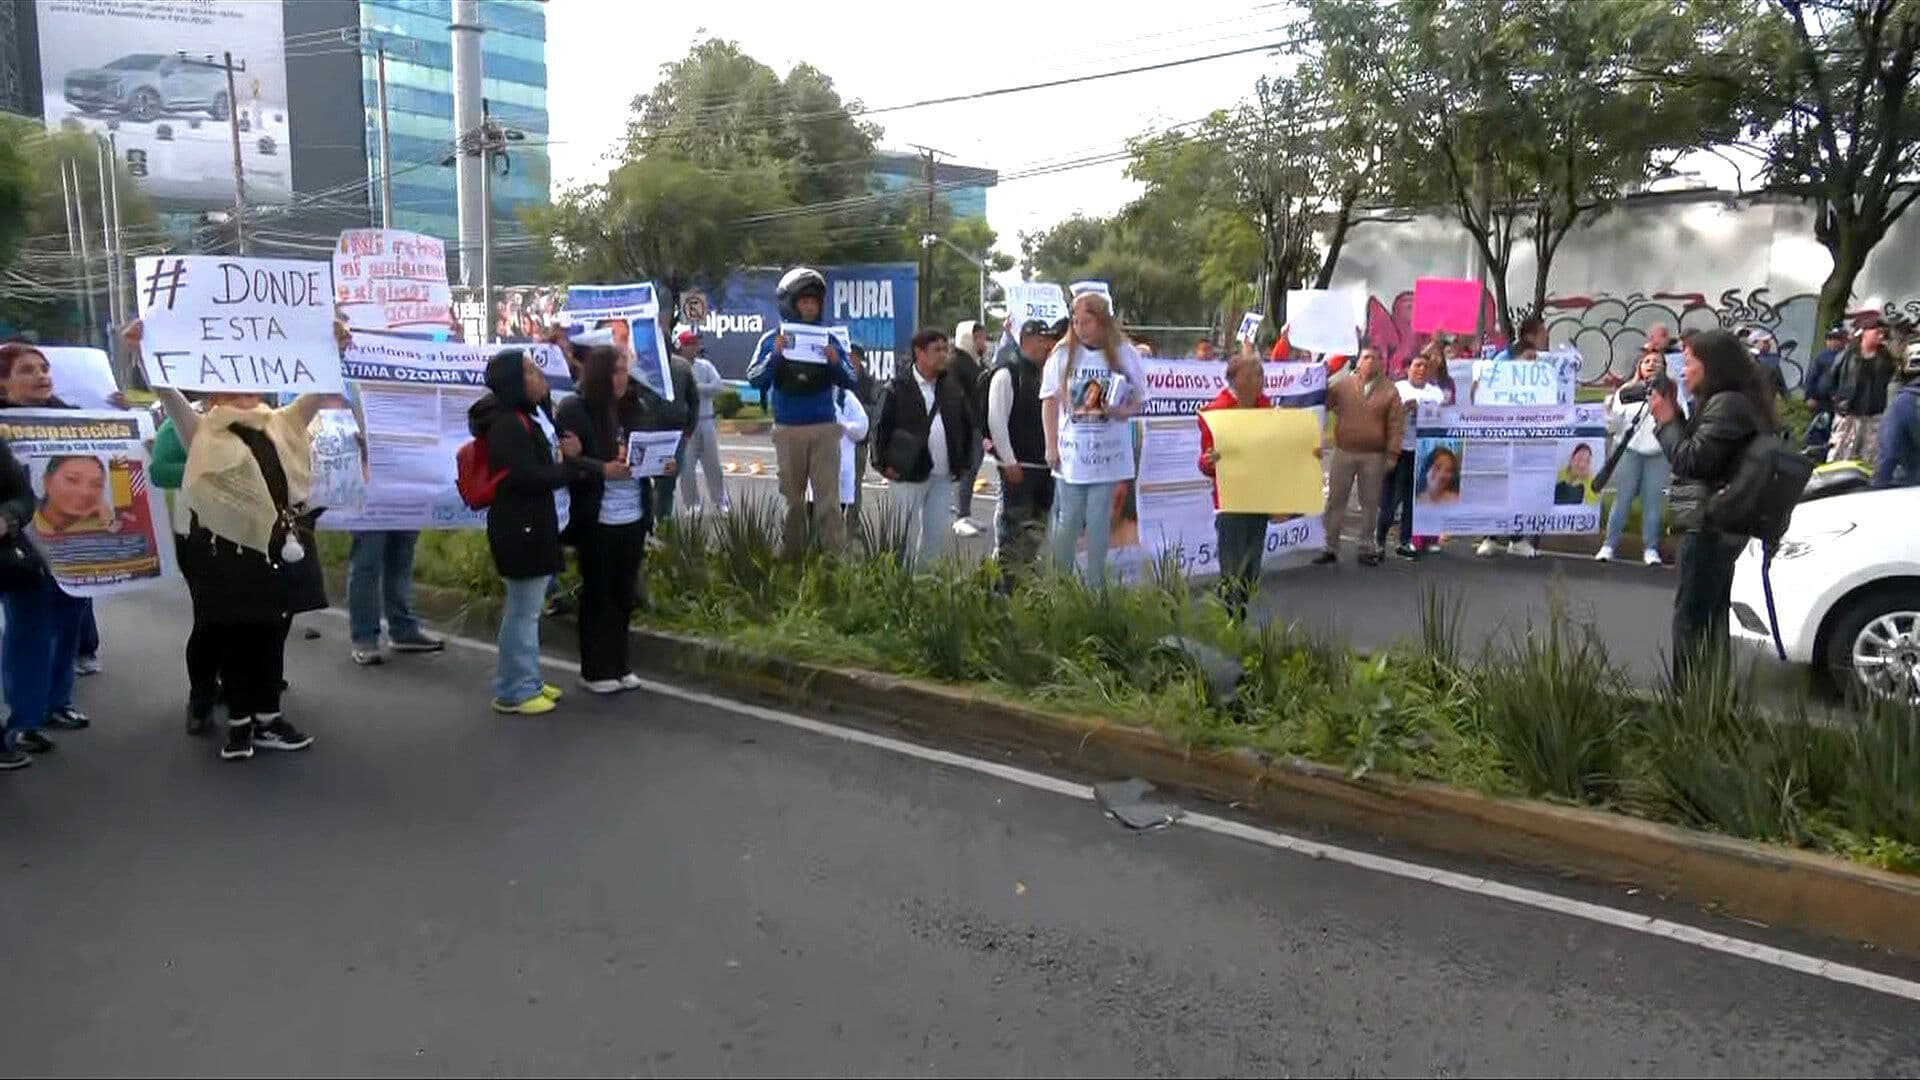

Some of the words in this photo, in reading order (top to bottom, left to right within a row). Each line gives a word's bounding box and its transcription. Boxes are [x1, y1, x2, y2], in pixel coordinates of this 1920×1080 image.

[144, 259, 187, 310] #
[212, 262, 323, 307] DONDE
[834, 280, 894, 319] PURA
[200, 316, 288, 342] ESTA
[153, 351, 316, 385] FATIMA
[341, 361, 391, 379] ATIMA
[394, 367, 461, 384] OZOARA
[465, 371, 487, 384] VA
[1146, 368, 1211, 389] yudanos
[1144, 400, 1178, 415] ATIMA
